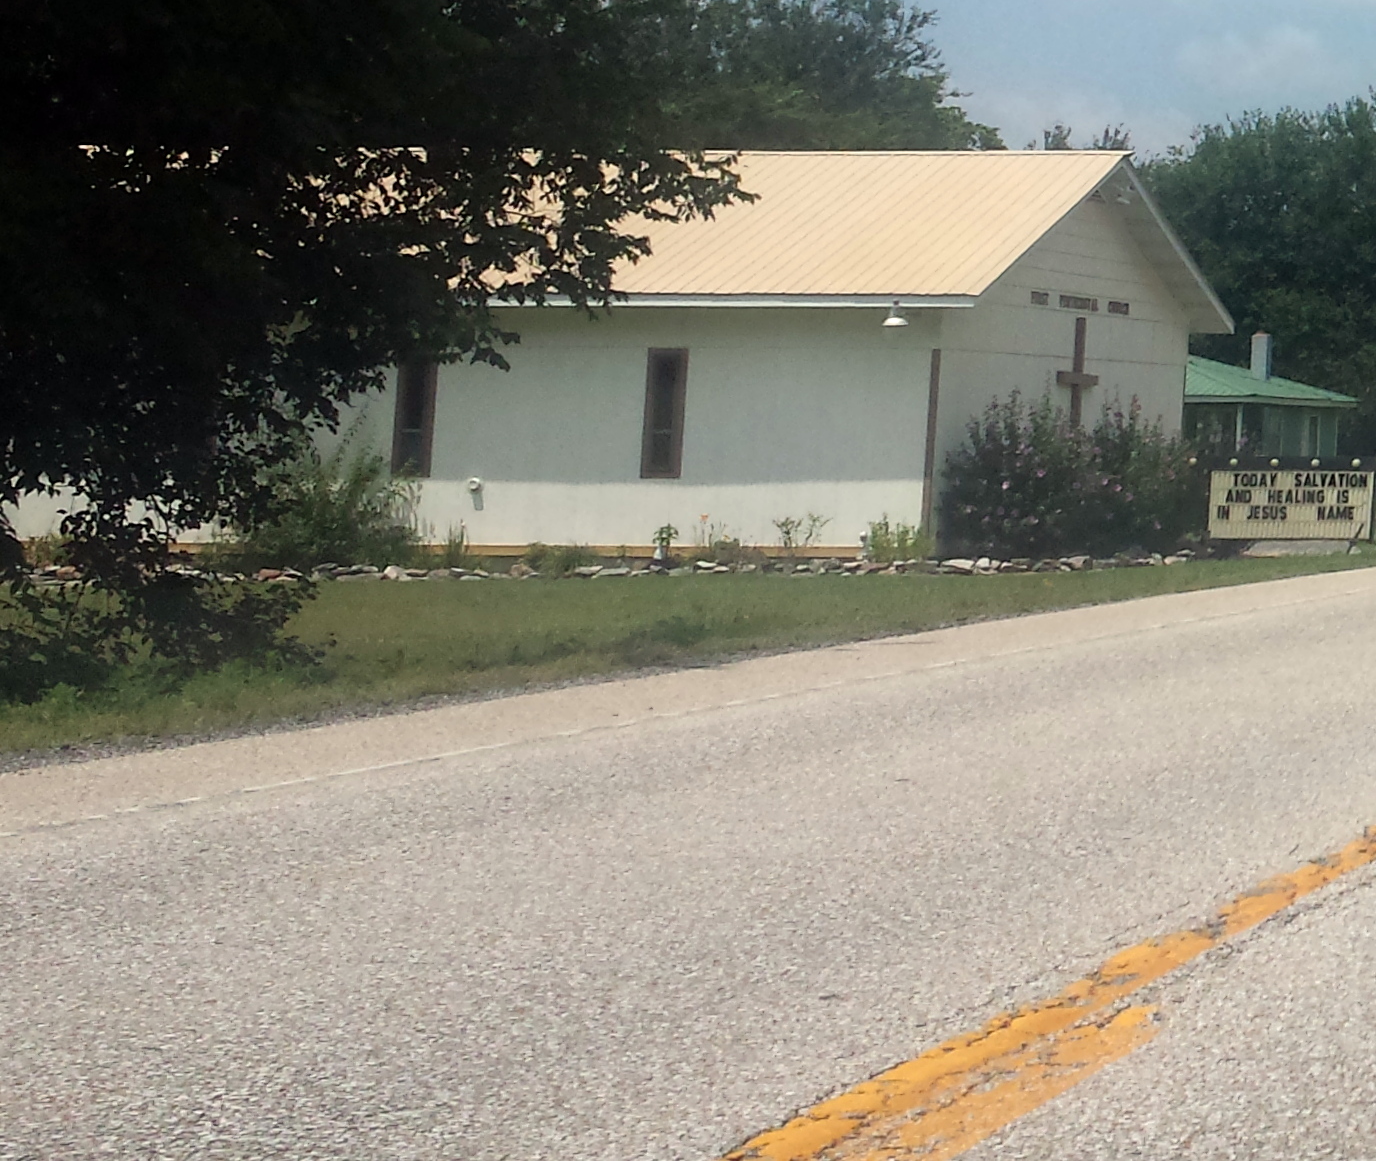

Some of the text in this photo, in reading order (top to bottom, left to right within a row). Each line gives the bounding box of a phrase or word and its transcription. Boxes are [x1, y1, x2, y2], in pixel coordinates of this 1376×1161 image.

[1234, 473, 1368, 487] TODAY SALVATION
[1226, 490, 1349, 504] AND HEALING IS
[1217, 506, 1355, 521] IN JESUS NAME
